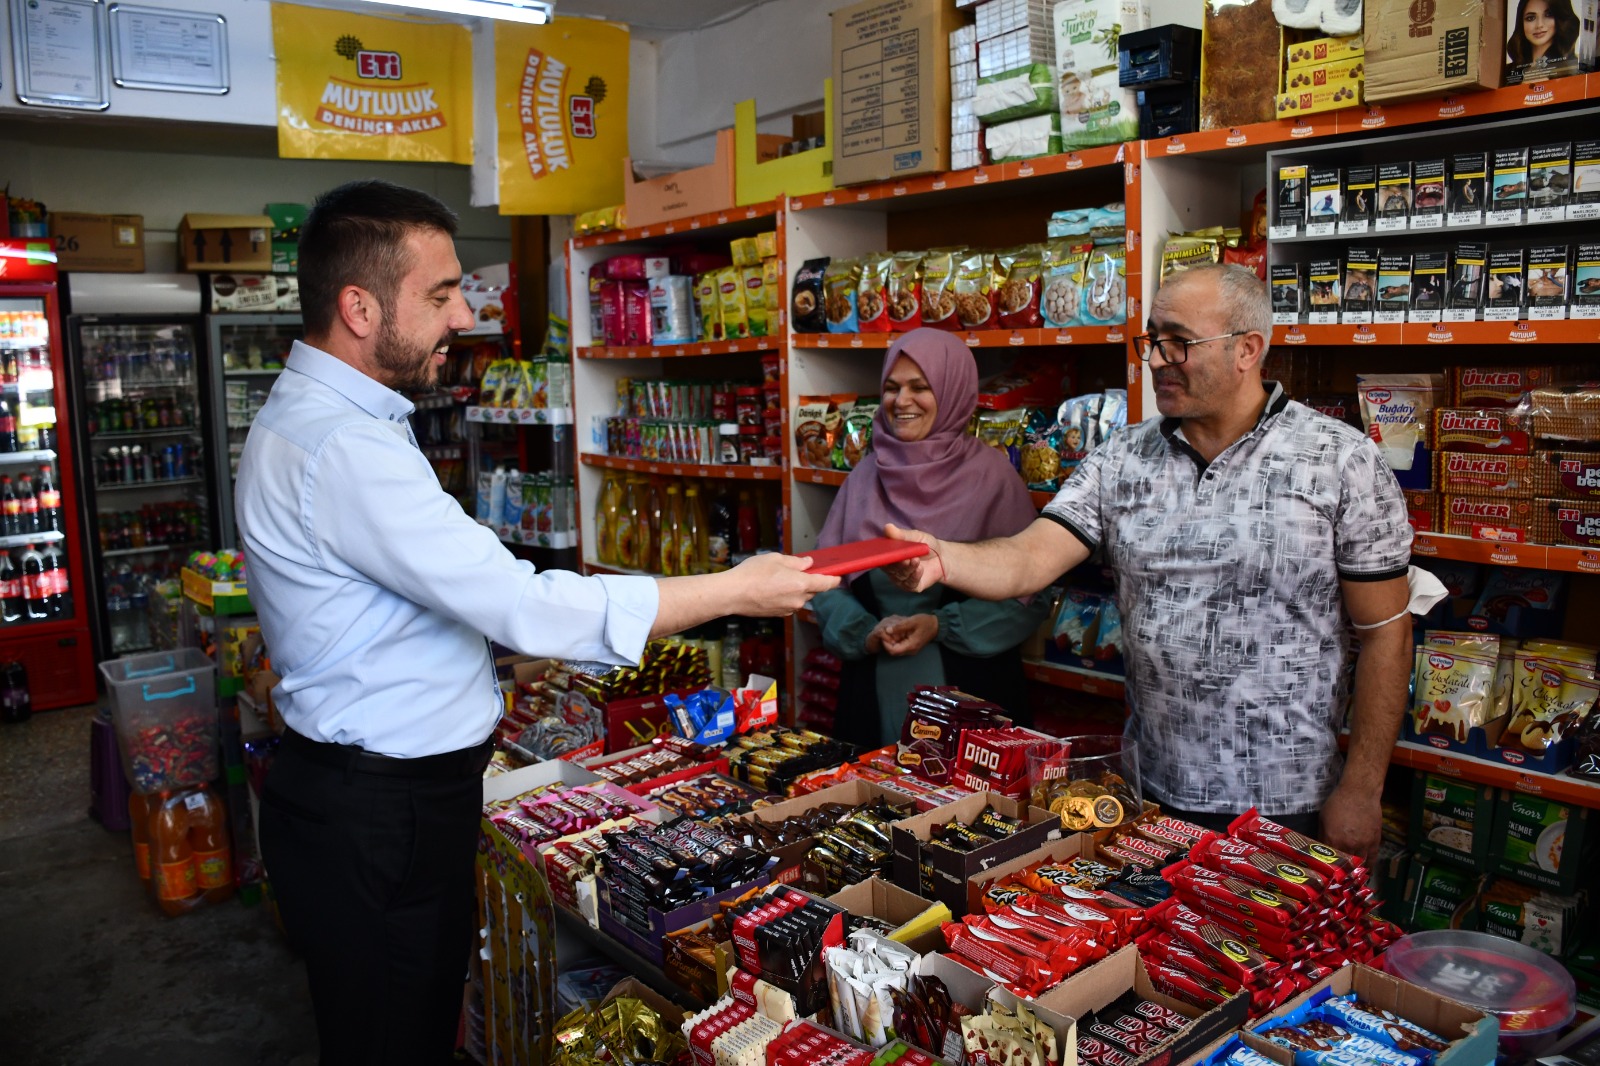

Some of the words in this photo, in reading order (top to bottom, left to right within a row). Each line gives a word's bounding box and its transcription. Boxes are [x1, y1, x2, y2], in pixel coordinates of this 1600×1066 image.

[1062, 17, 1095, 37] Turco
[1446, 29, 1467, 69] 31113
[321, 82, 438, 116] MUTLULUK
[538, 56, 569, 172] MUTLULUK
[400, 116, 441, 133] AKLA
[525, 132, 542, 174] AKLA
[1462, 369, 1521, 387] ÜLKER
[1375, 414, 1417, 426] Nişastası
[1379, 404, 1416, 416] Buğday
[1441, 412, 1501, 432] ÜLKER
[1448, 455, 1508, 475] ÜLKER
[1451, 498, 1511, 519] ÜLKER
[1429, 684, 1459, 695] Sos
[912, 725, 941, 738] Caramio
[1512, 802, 1542, 820] Knorr
[1137, 823, 1191, 845] Albeni
[1103, 845, 1155, 867] Albeni
[1118, 836, 1171, 860] Albeni
[1432, 878, 1461, 895] Knorr
[1487, 904, 1518, 922] Knorr
[1532, 911, 1555, 922] Knorr
[1346, 1014, 1371, 1031] BUMBA
[1093, 1023, 1156, 1056] AXIMUS
[1077, 1036, 1132, 1066] MAXIM
